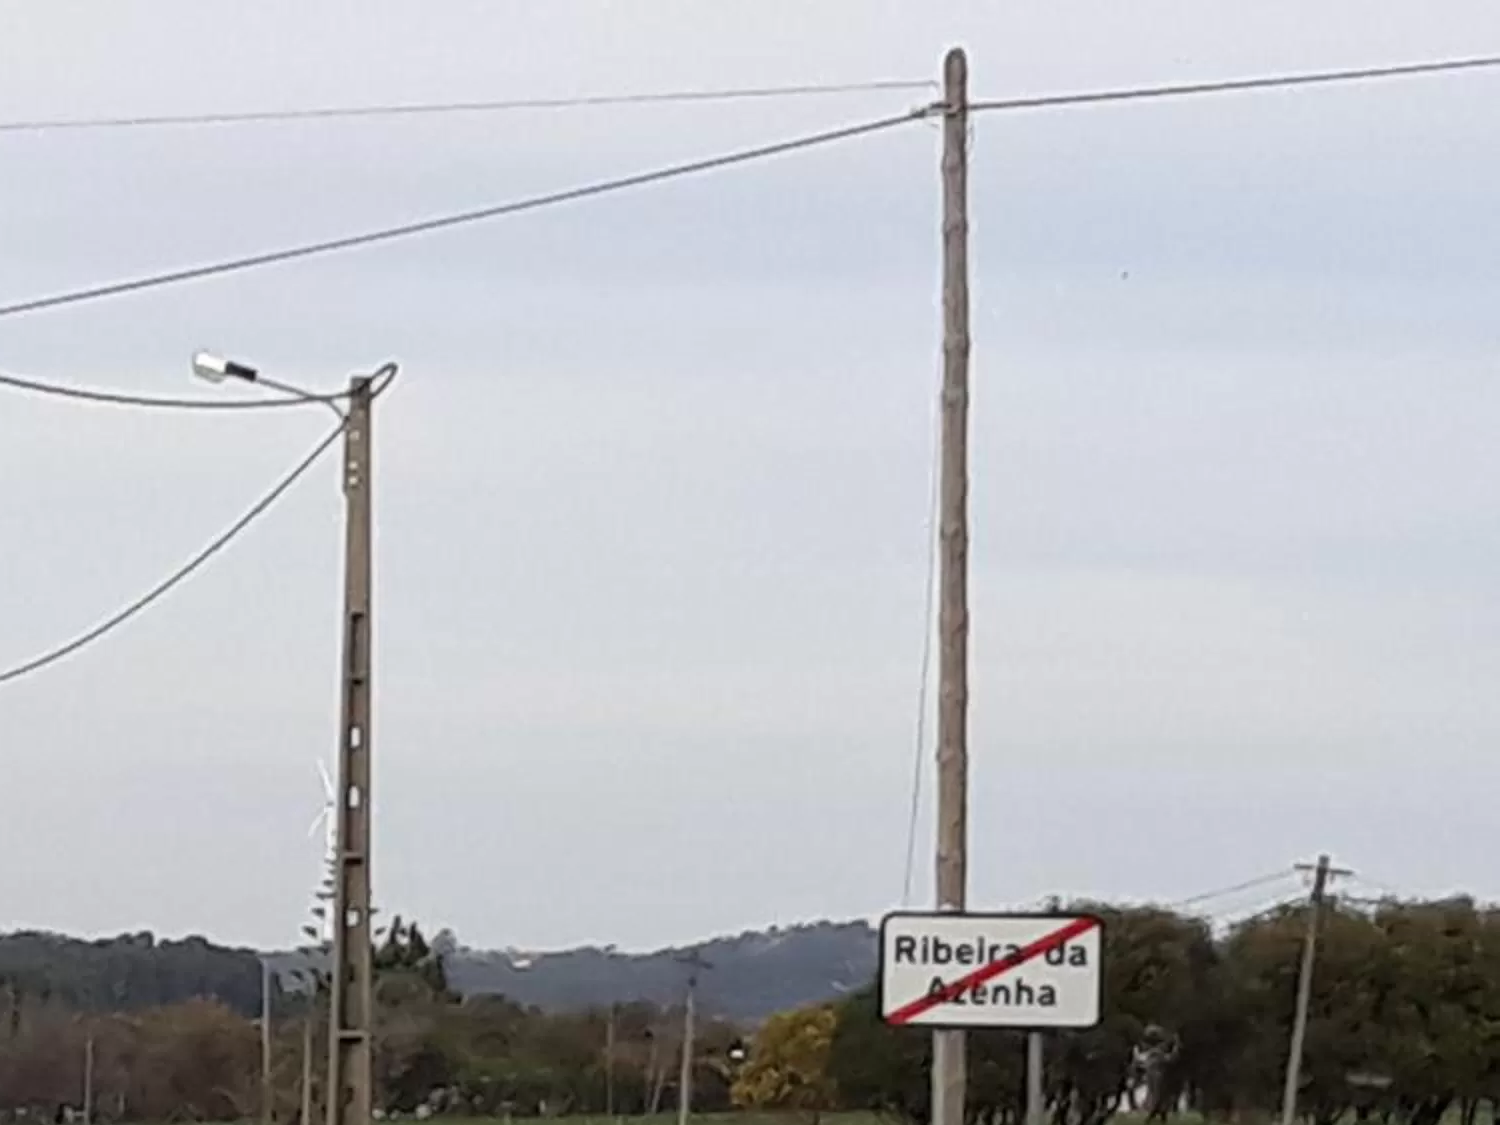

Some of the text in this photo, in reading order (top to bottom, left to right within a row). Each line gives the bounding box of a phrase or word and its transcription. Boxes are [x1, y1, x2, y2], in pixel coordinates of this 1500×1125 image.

[894, 935, 1088, 967] Ribeira da
[927, 976, 1057, 1007] Azenha
